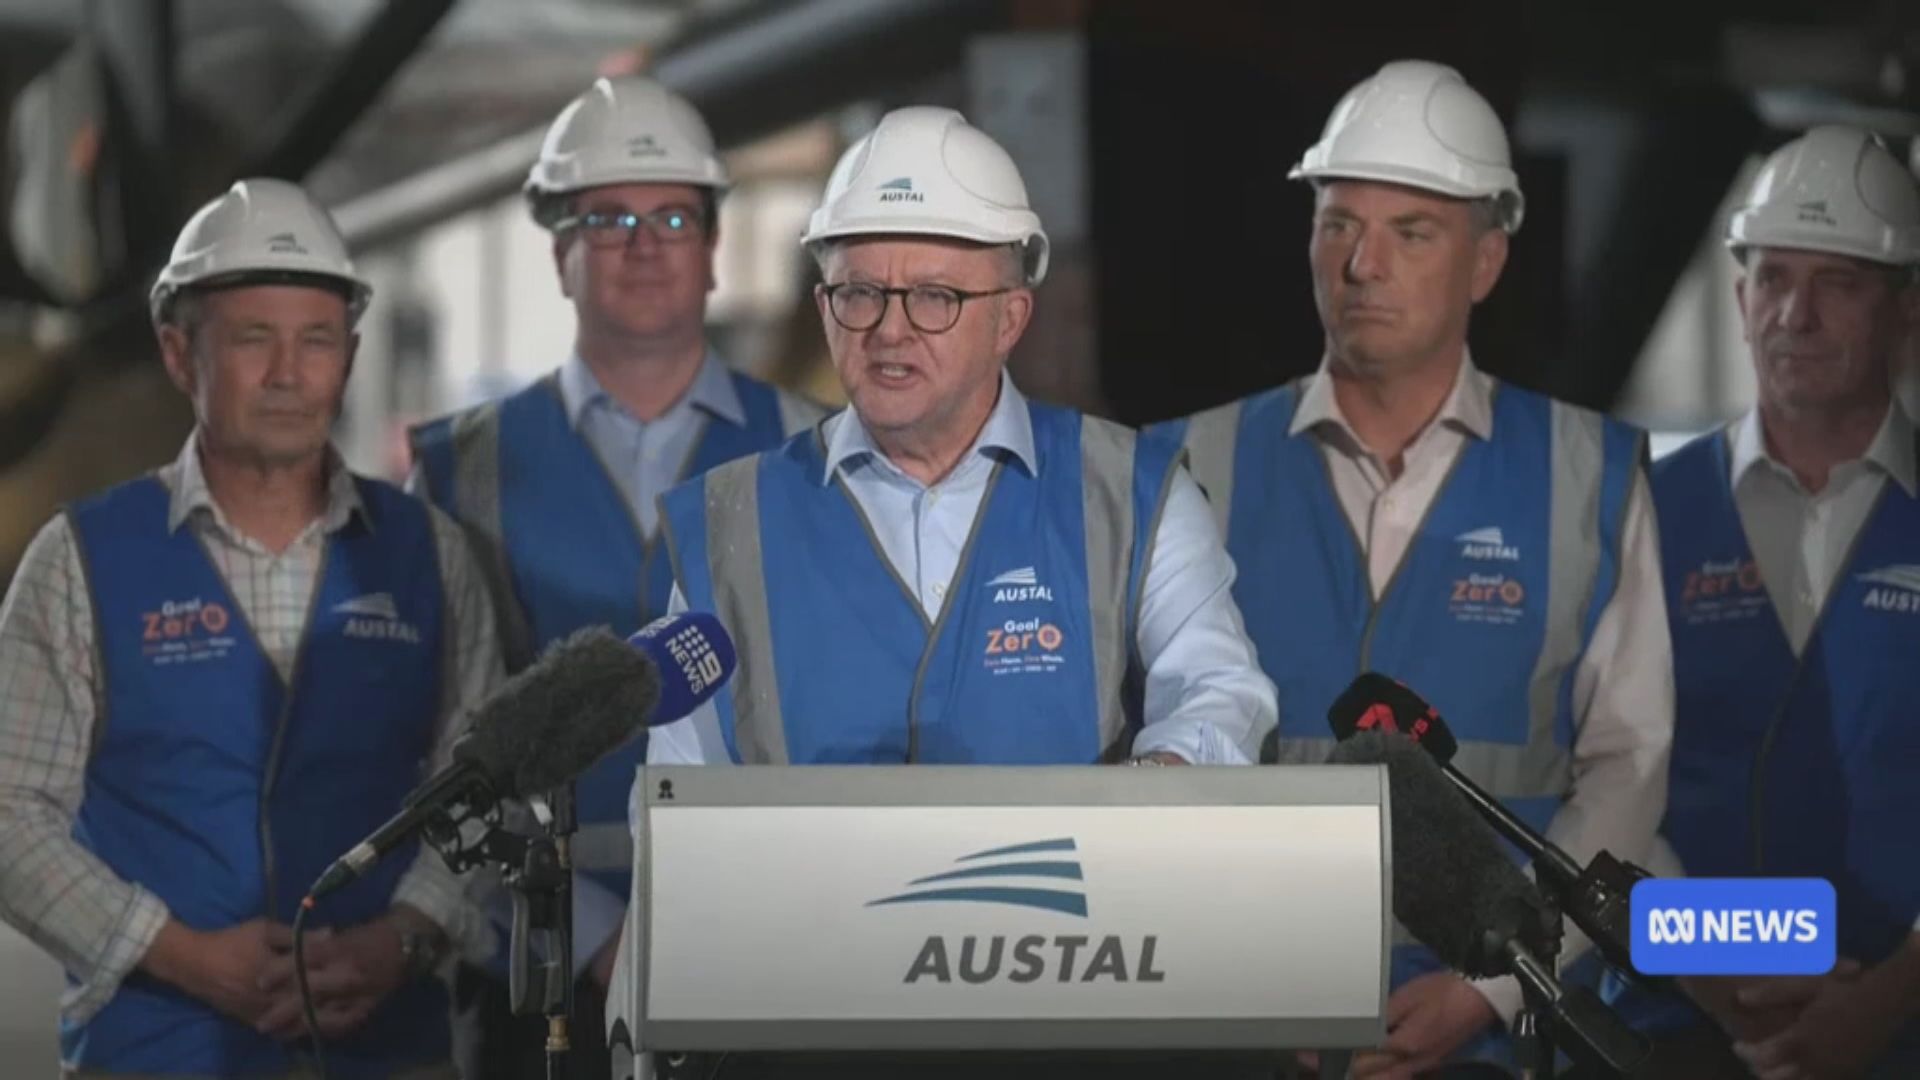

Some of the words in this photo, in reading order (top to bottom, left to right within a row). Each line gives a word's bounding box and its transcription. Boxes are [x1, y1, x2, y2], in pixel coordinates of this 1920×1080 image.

[994, 586, 1053, 603] AUSTAL
[1004, 617, 1040, 633] Goal
[665, 637, 704, 695] NEWS
[903, 935, 1166, 984] AUSTAL
